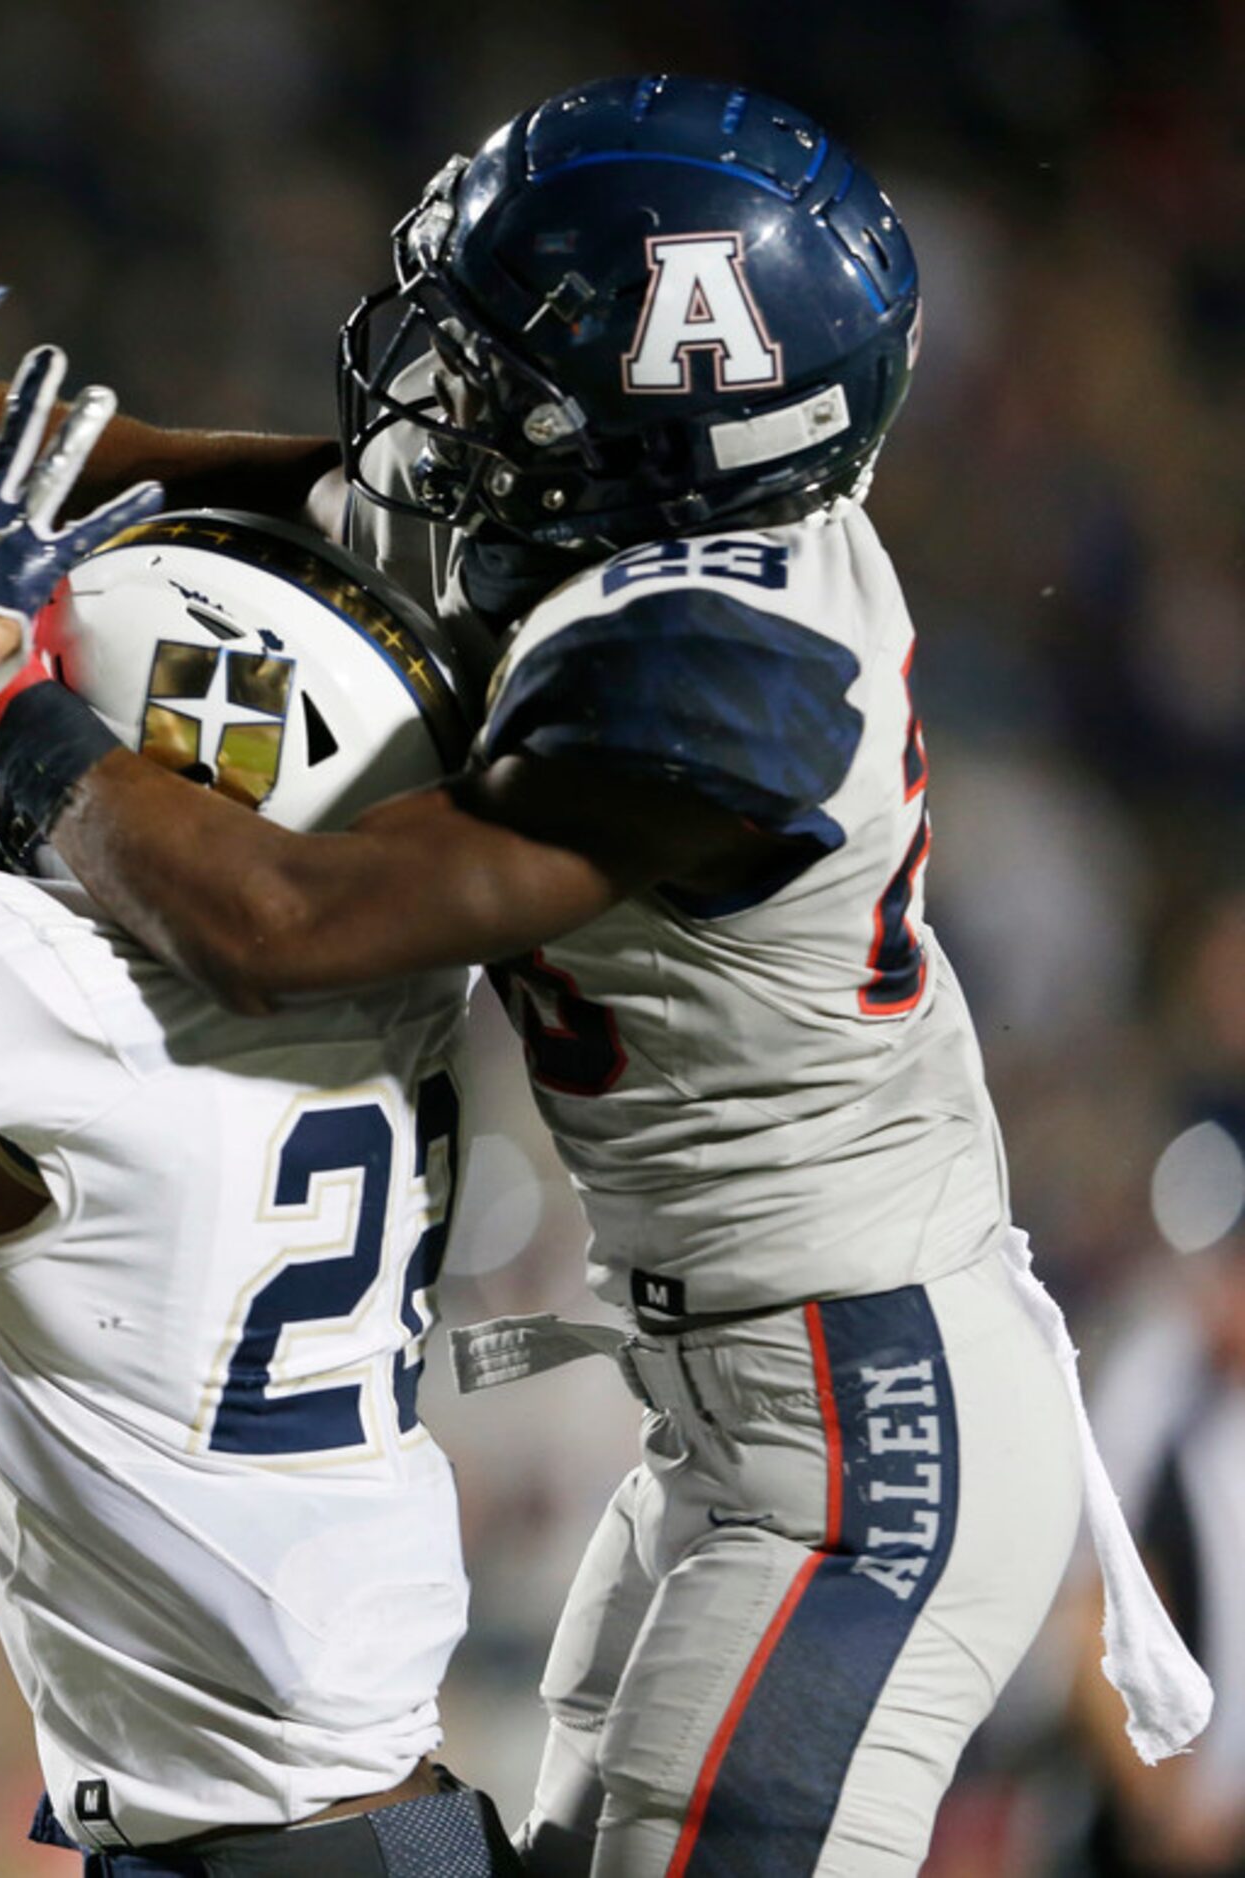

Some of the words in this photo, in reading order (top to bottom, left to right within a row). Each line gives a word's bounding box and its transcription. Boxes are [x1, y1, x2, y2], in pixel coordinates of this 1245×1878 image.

[622, 231, 783, 393] A
[601, 539, 788, 597] 23
[851, 1358, 942, 1601] ALLEN
